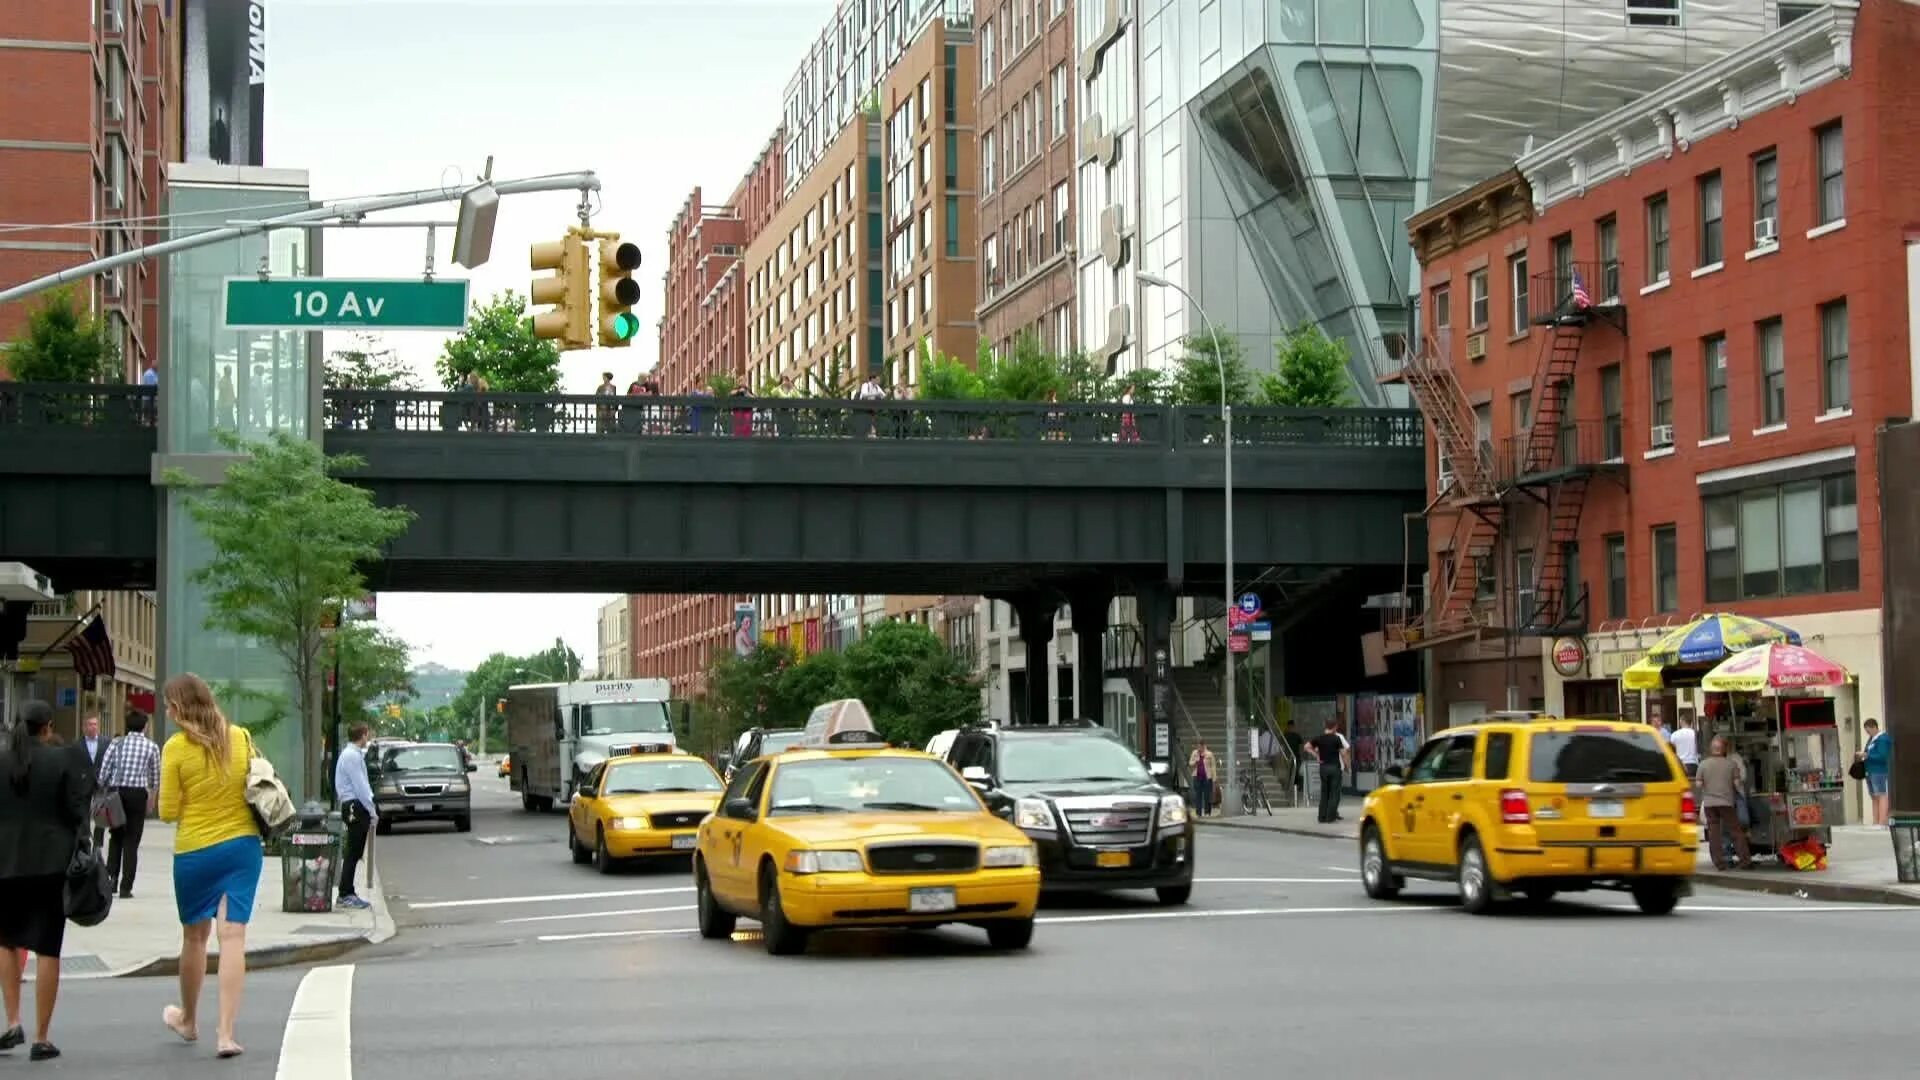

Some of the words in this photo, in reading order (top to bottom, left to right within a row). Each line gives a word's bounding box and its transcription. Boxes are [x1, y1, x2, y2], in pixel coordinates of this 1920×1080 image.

[249, 0, 265, 85] oMA
[294, 290, 328, 317] 10
[337, 290, 385, 317] Av
[595, 682, 633, 693] purity
